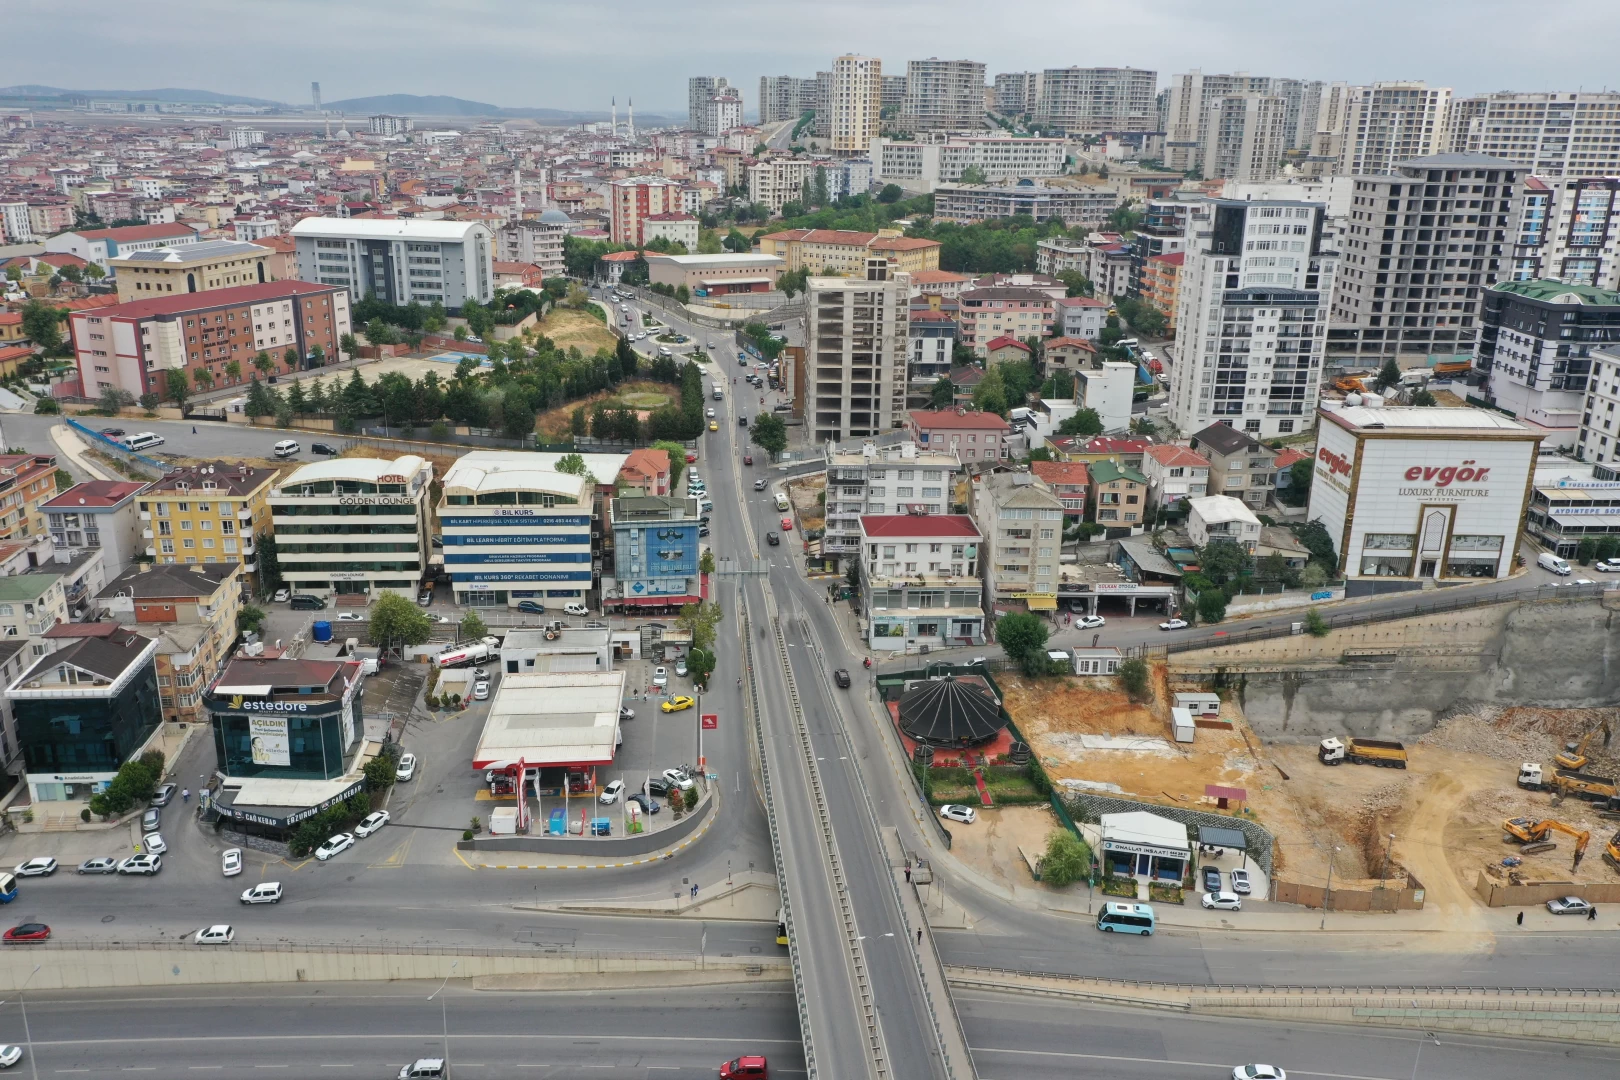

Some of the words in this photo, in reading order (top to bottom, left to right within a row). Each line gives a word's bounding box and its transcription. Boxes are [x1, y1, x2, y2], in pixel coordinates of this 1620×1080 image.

[1319, 447, 1352, 477] evgör
[1404, 460, 1490, 487] evgör
[377, 474, 406, 483] HOTEL
[1399, 488, 1434, 496] LUXURY
[1436, 488, 1489, 497] FURNITURE
[340, 497, 375, 505] GOLDEN
[379, 497, 414, 505] LOUNGE
[243, 701, 307, 711] estedore
